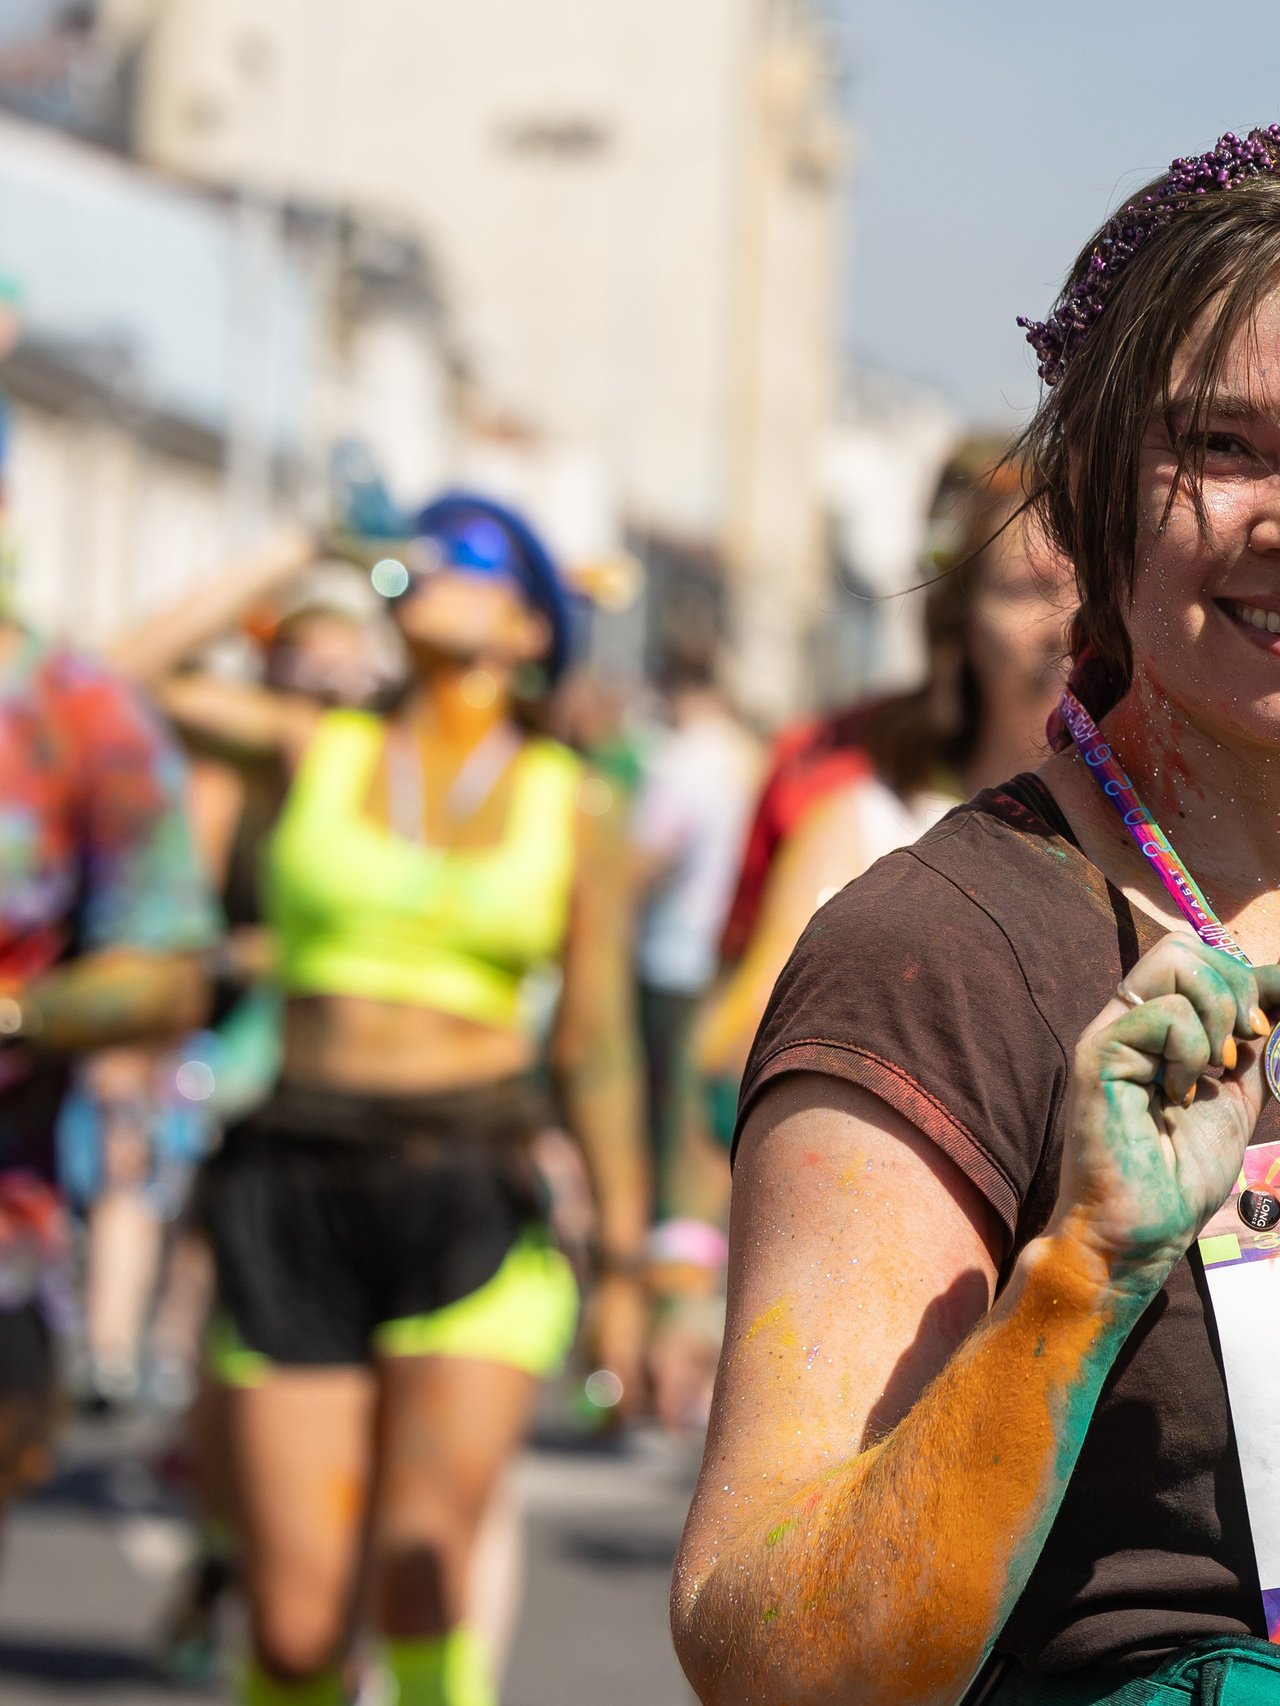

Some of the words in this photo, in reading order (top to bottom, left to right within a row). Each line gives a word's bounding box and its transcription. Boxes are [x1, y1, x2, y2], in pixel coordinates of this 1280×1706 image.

[1085, 744, 1172, 857] 2026
[1168, 868, 1207, 920] ЗАБЕГ
[1251, 1196, 1263, 1226] DISTANCE
[1257, 1197, 1273, 1228] LONG
